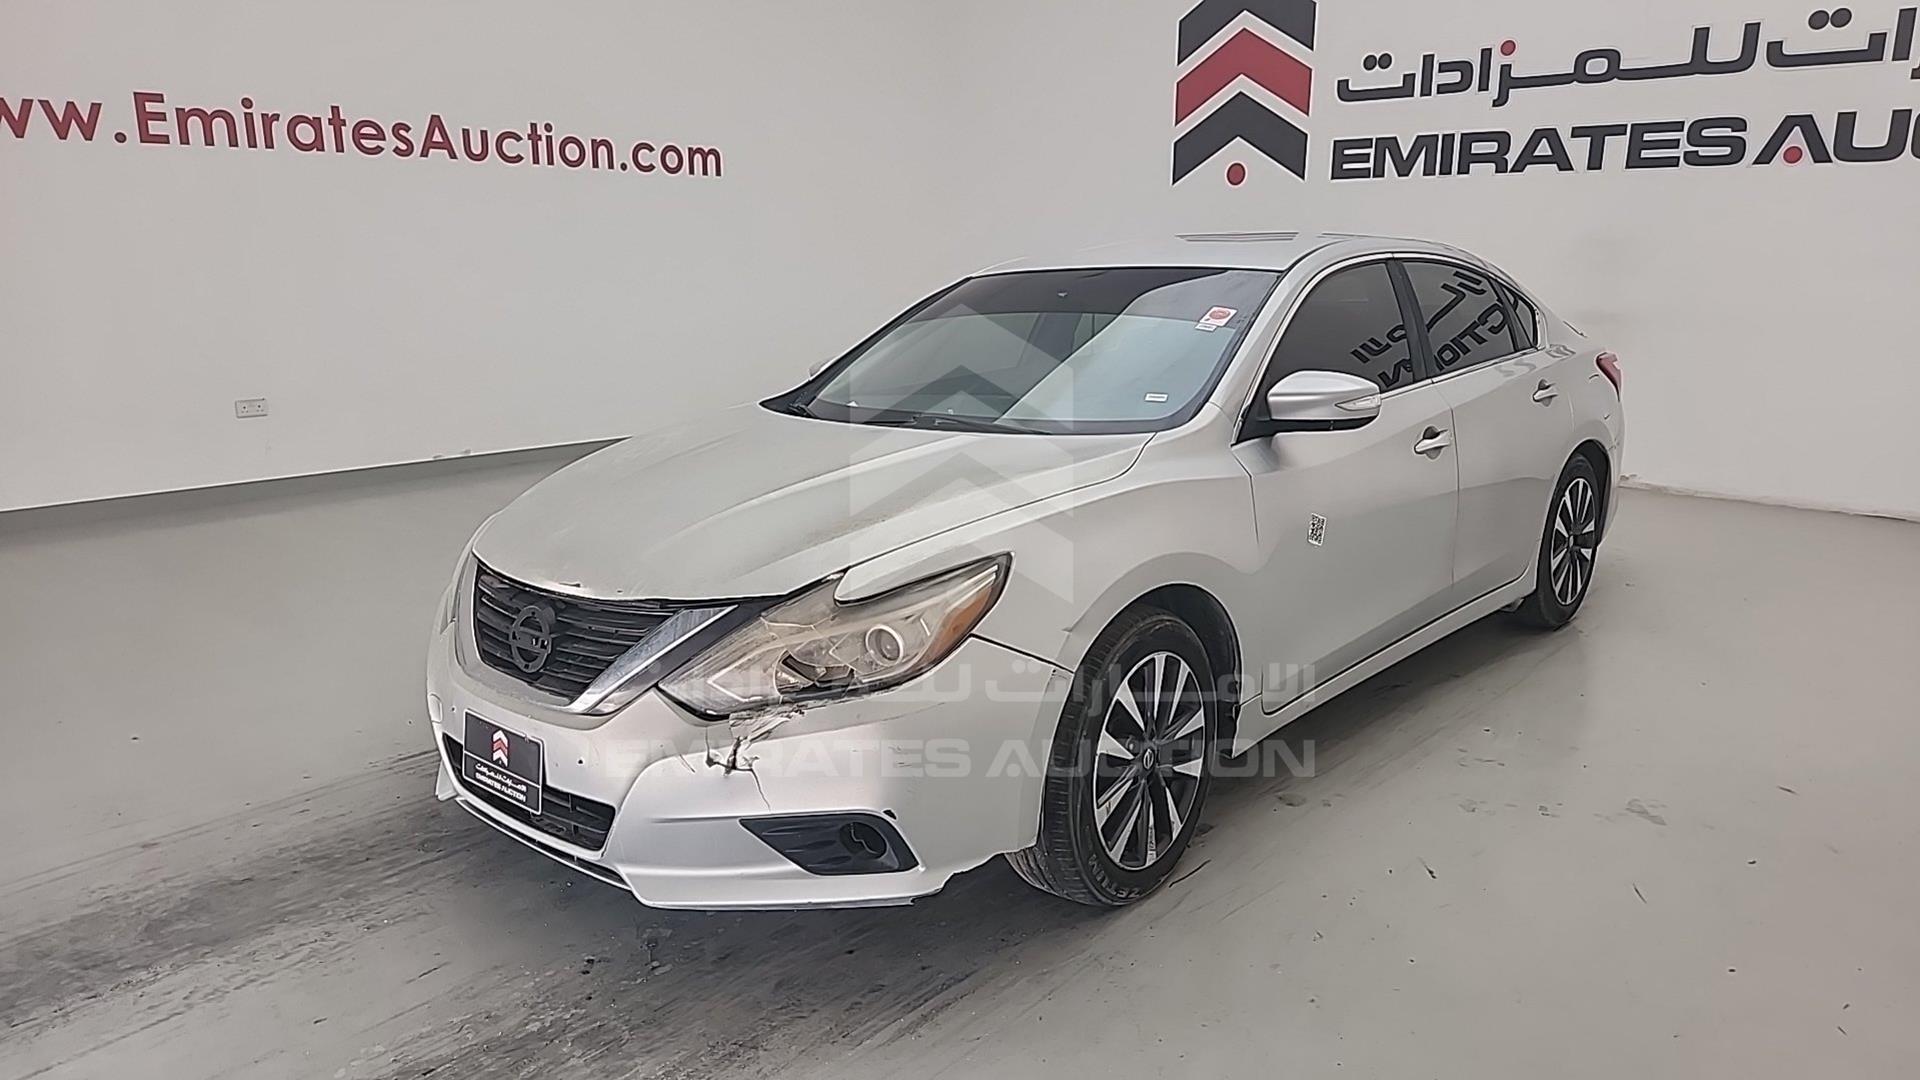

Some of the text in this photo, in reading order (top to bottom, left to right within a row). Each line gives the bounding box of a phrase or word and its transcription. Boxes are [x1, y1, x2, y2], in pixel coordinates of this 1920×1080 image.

[1337, 22, 1762, 108] للمزادات
[1330, 109, 1920, 181] EMIRATES AU
